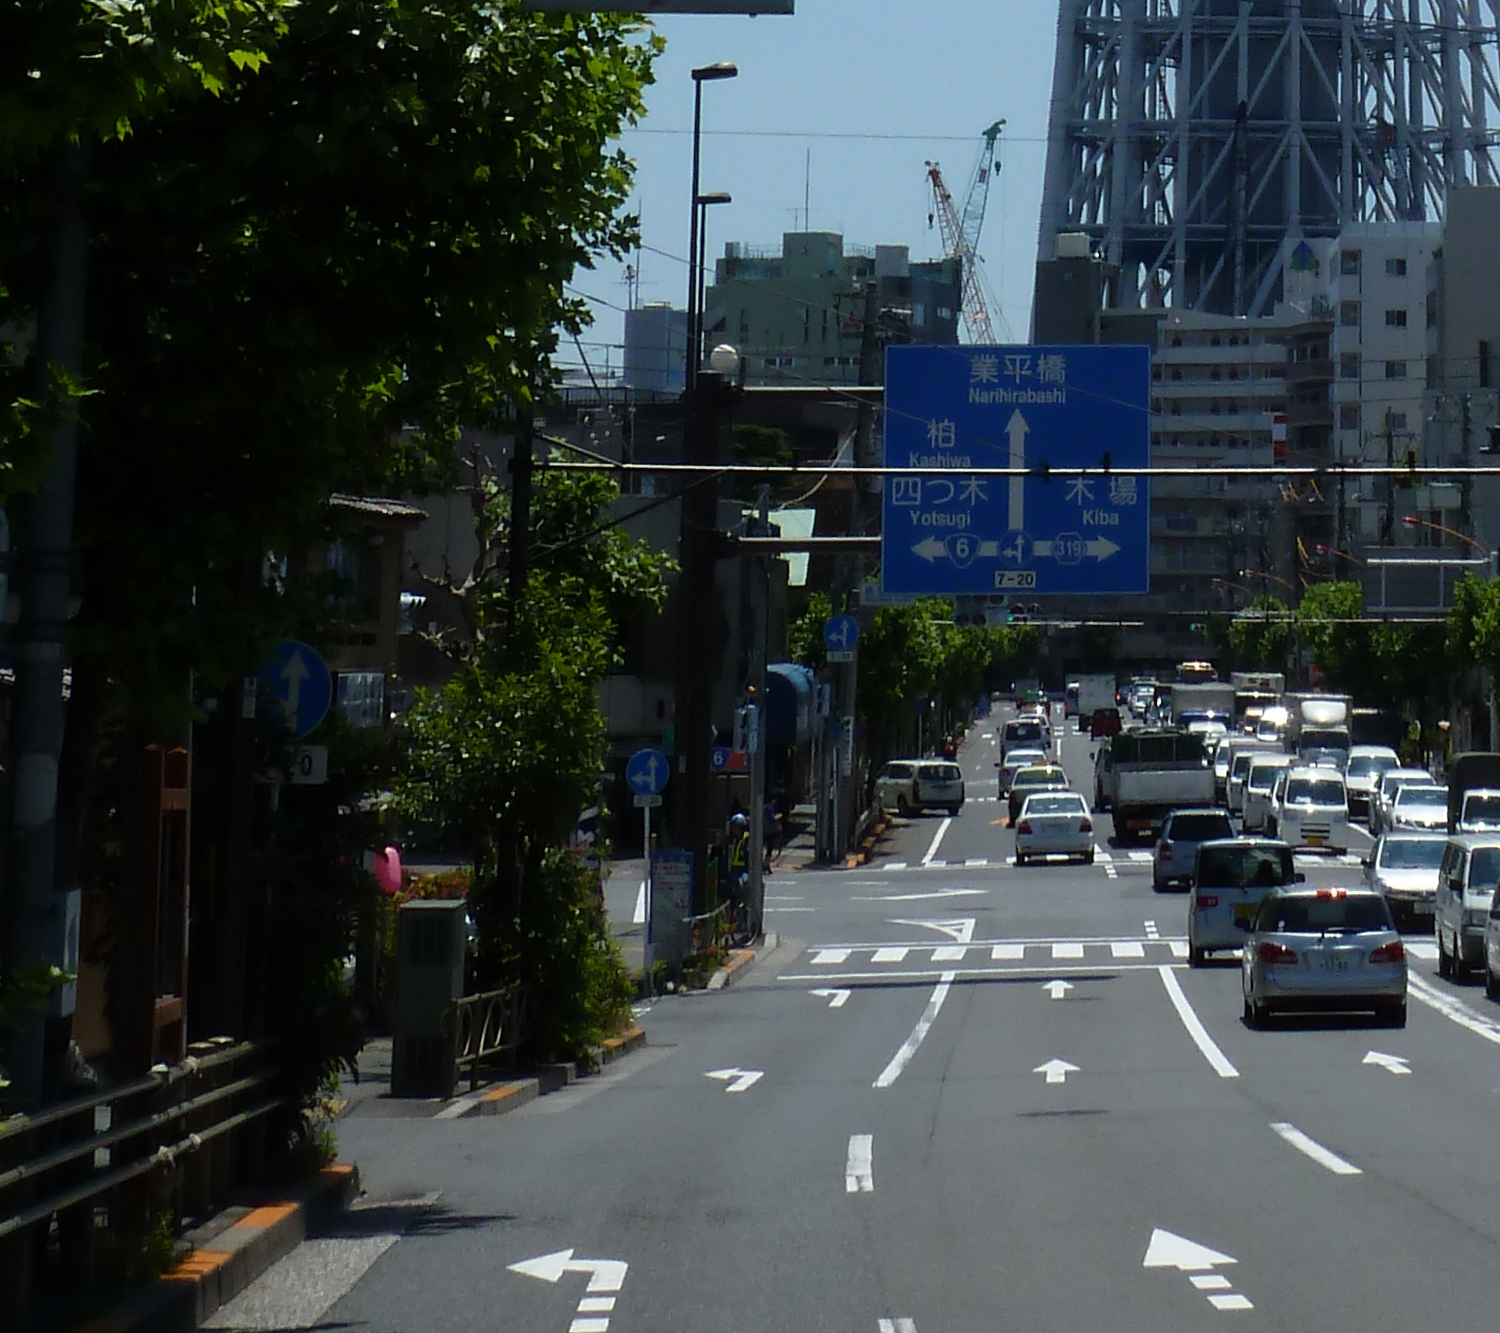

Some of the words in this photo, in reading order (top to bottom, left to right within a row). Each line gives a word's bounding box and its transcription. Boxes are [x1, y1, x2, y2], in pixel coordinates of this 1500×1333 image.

[969, 353, 1067, 384] 業平橋
[968, 387, 1067, 404] Narihirabashi
[927, 418, 956, 449] 柏
[908, 452, 972, 469] Kashiwa
[891, 476, 988, 506] 四つ木
[1065, 475, 1138, 506] 木場
[909, 510, 971, 528] Yotsugi
[1082, 509, 1120, 526] Kiba
[955, 539, 969, 559] 6
[1056, 539, 1082, 558] 319
[996, 572, 1035, 587] 7-20
